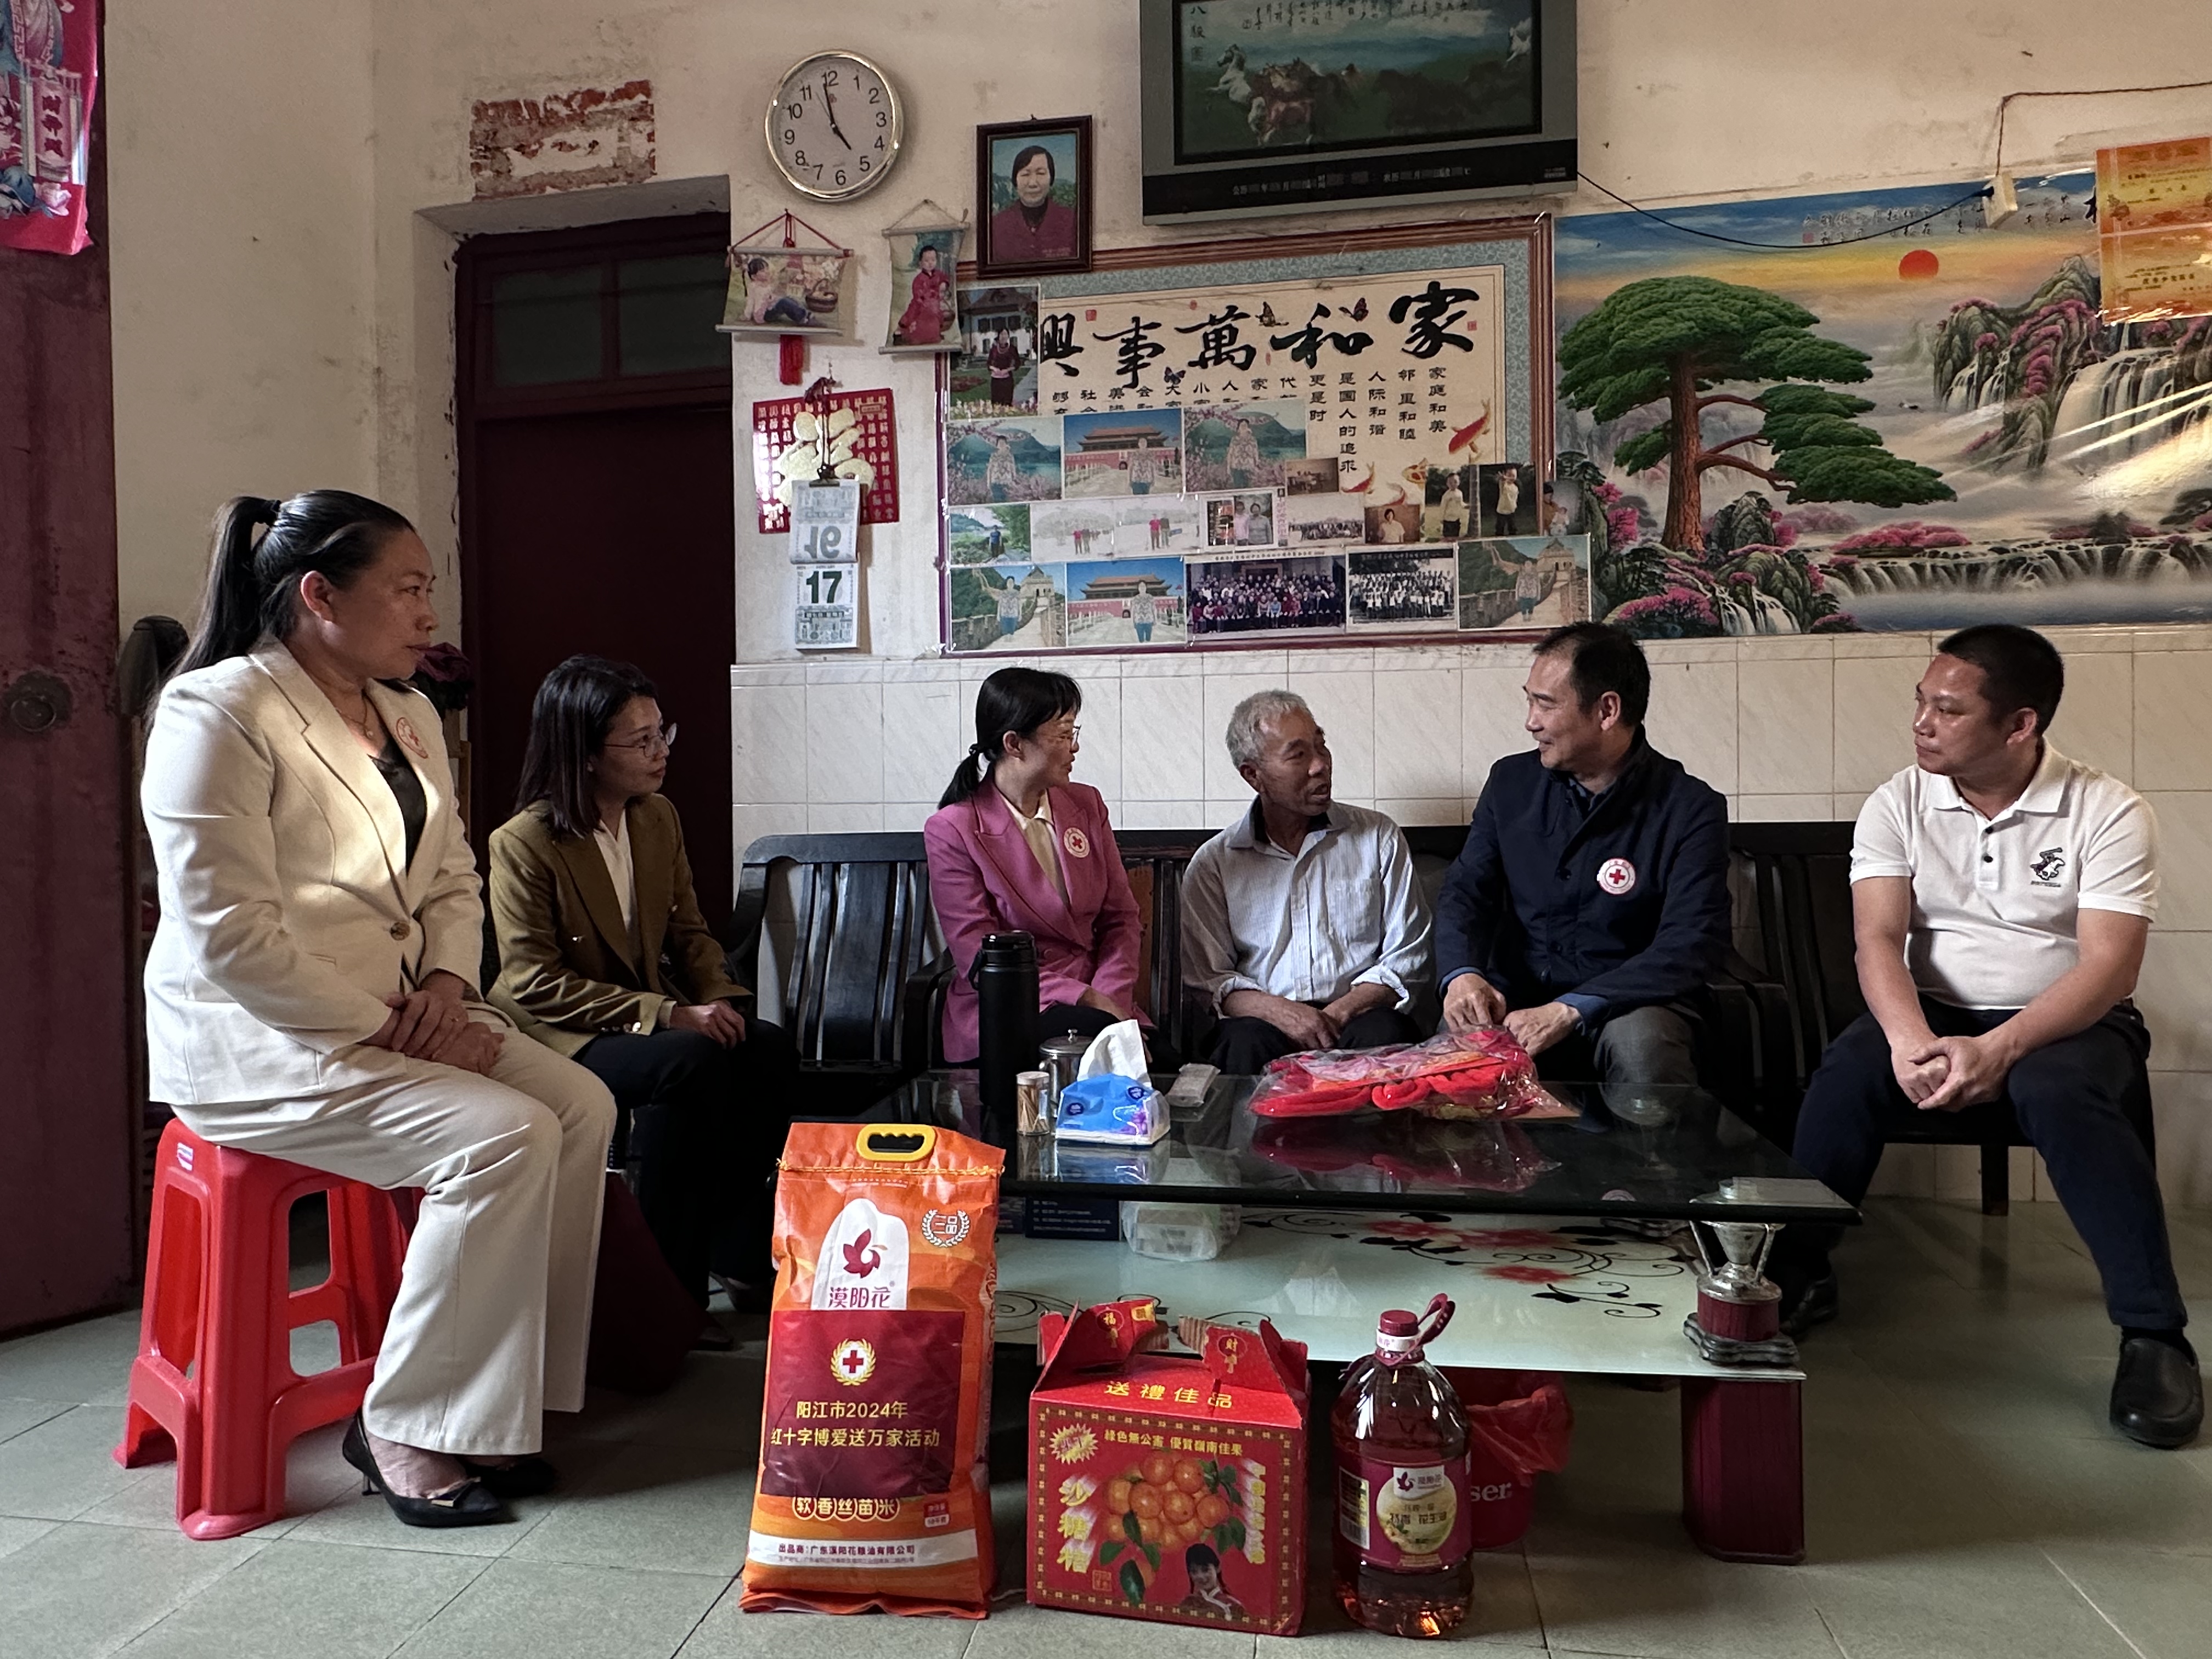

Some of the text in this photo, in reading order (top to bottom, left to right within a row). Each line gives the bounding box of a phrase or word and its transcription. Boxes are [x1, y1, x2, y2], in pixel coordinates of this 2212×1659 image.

[822, 71, 839, 87] 12
[853, 75, 860, 91] 1
[799, 85, 812, 100] 11
[869, 88, 879, 104] 2
[787, 103, 803, 120] 10
[876, 112, 887, 127] 3
[785, 129, 794, 144] 9
[874, 136, 885, 151] 4
[795, 150, 805, 165] 8
[859, 156, 870, 172] 5
[813, 163, 823, 180] 7
[835, 170, 846, 185] 6
[1309, 374, 1327, 421] 更是时
[1368, 371, 1386, 436] 人际和谐
[1398, 369, 1417, 439] 邻里和睦
[1428, 366, 1447, 432] 家庭和美
[1339, 372, 1357, 472] 是国人的追求
[806, 571, 842, 603] 17
[828, 1286, 891, 1308] 漠阳花
[1104, 1381, 1232, 1408] 送禮佳品
[797, 1400, 908, 1419] 阳江市2024年
[771, 1427, 940, 1447] 红十字博爱送万家活动
[797, 1498, 894, 1515] 软香丝苗米
